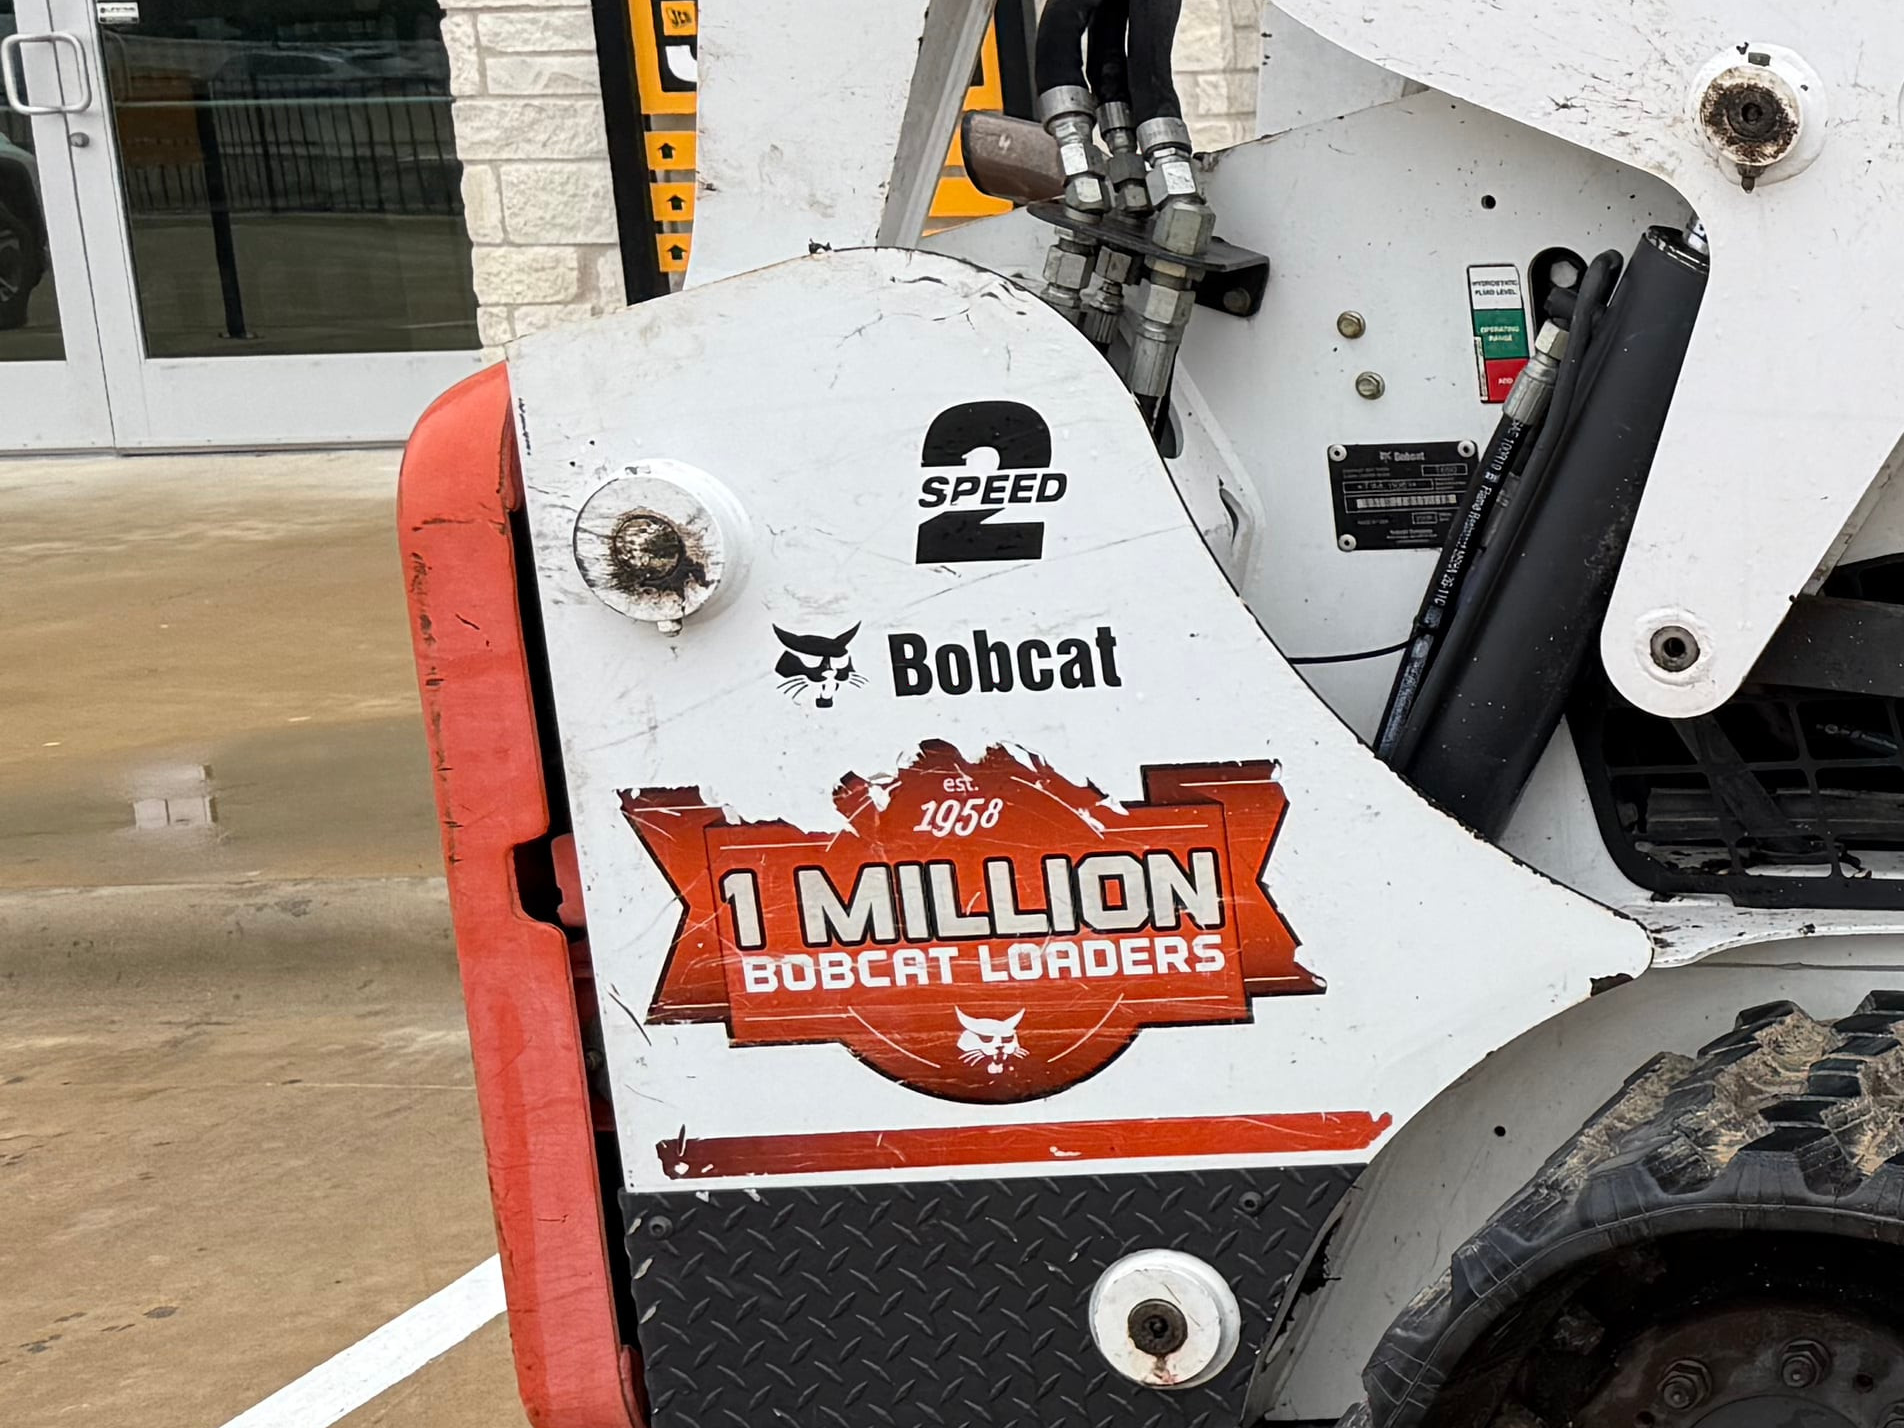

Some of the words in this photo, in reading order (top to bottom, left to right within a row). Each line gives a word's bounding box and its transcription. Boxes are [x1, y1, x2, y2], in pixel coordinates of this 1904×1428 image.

[915, 399, 1053, 565] 2
[917, 471, 1068, 509] SPEED
[888, 626, 1123, 697] Bobcat
[942, 774, 979, 793] est.
[913, 799, 1004, 838] 1958
[721, 868, 764, 951] 1
[799, 848, 1224, 947] MILLION
[743, 946, 959, 994] BOBCAT
[980, 932, 1227, 983] LOADERS
